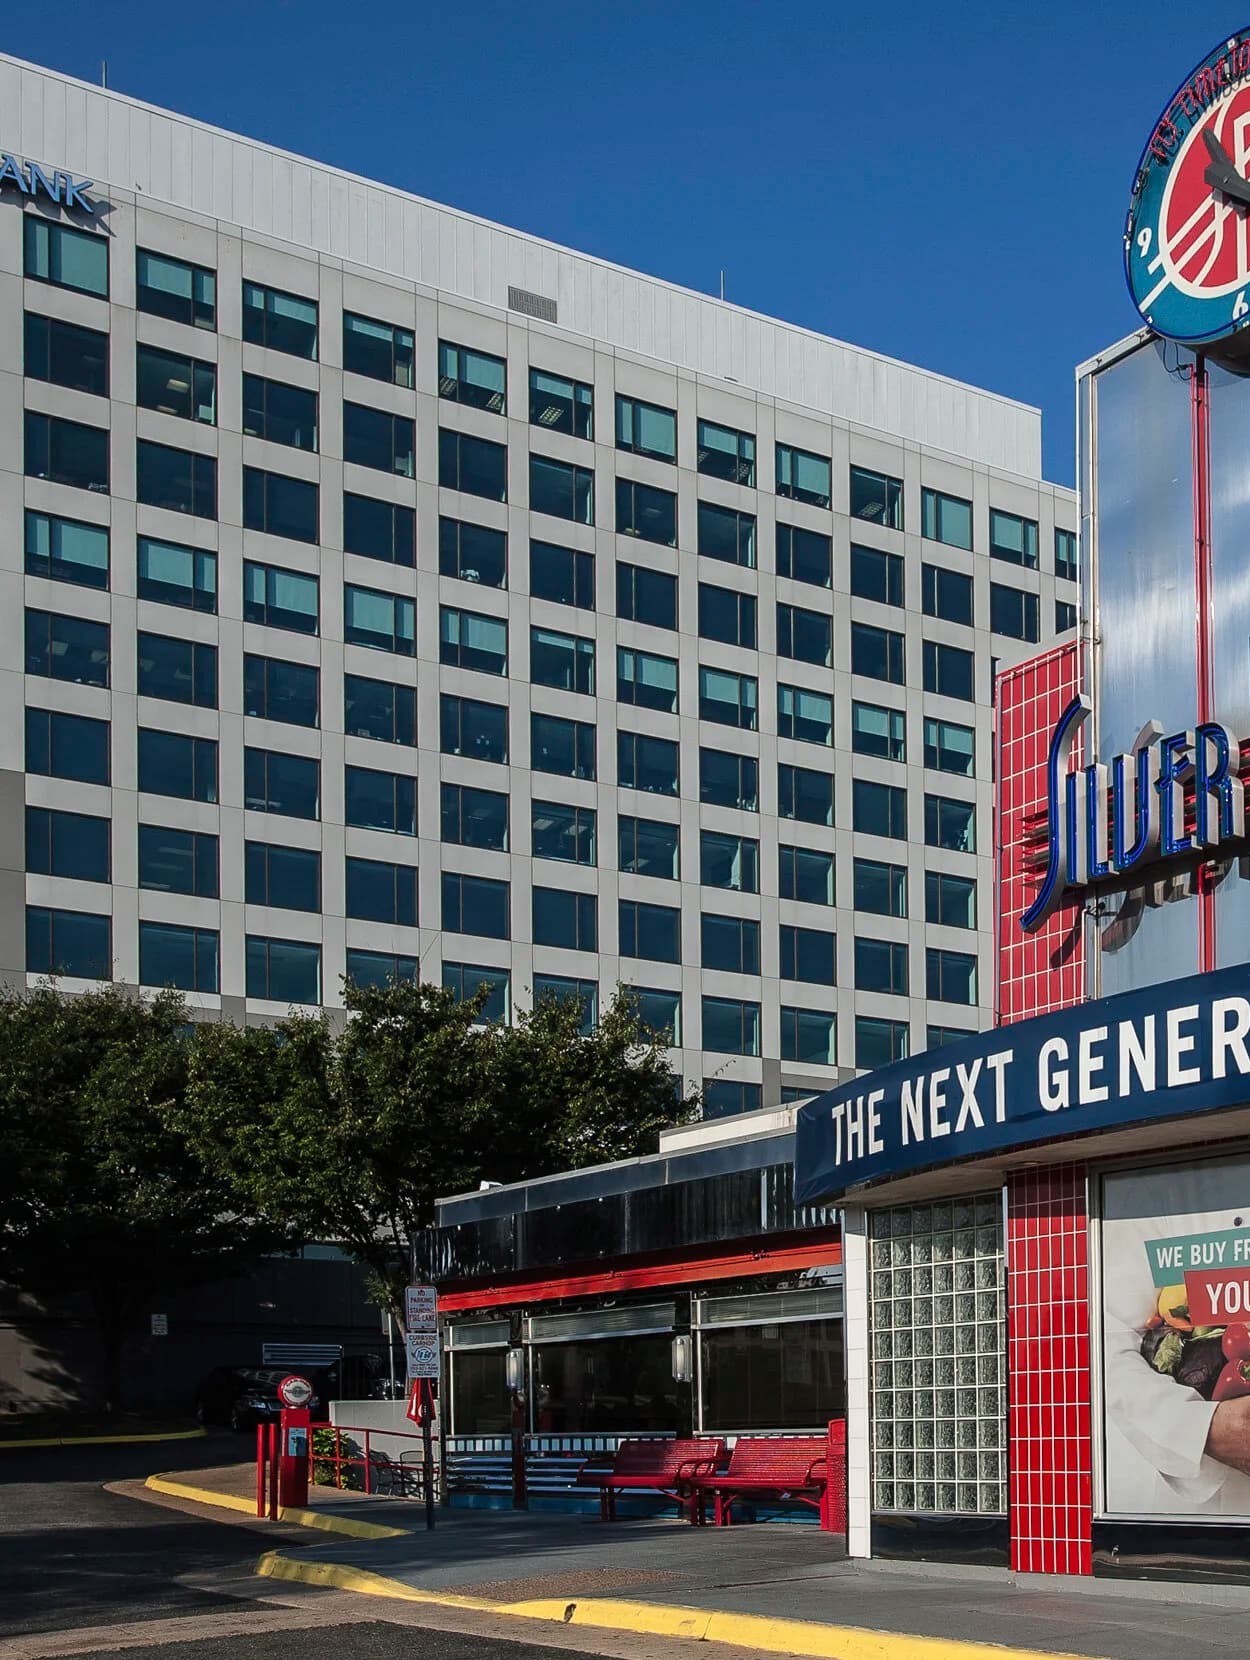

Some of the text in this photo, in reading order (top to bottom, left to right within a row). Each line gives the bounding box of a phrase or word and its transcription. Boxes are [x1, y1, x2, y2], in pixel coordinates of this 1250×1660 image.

[1137, 227, 1152, 258] 9
[1232, 290, 1249, 320] 6
[831, 1088, 885, 1167] THE
[900, 1048, 1014, 1146] NEXT
[1156, 1246, 1184, 1268] WE
[1190, 1241, 1227, 1266] BUY
